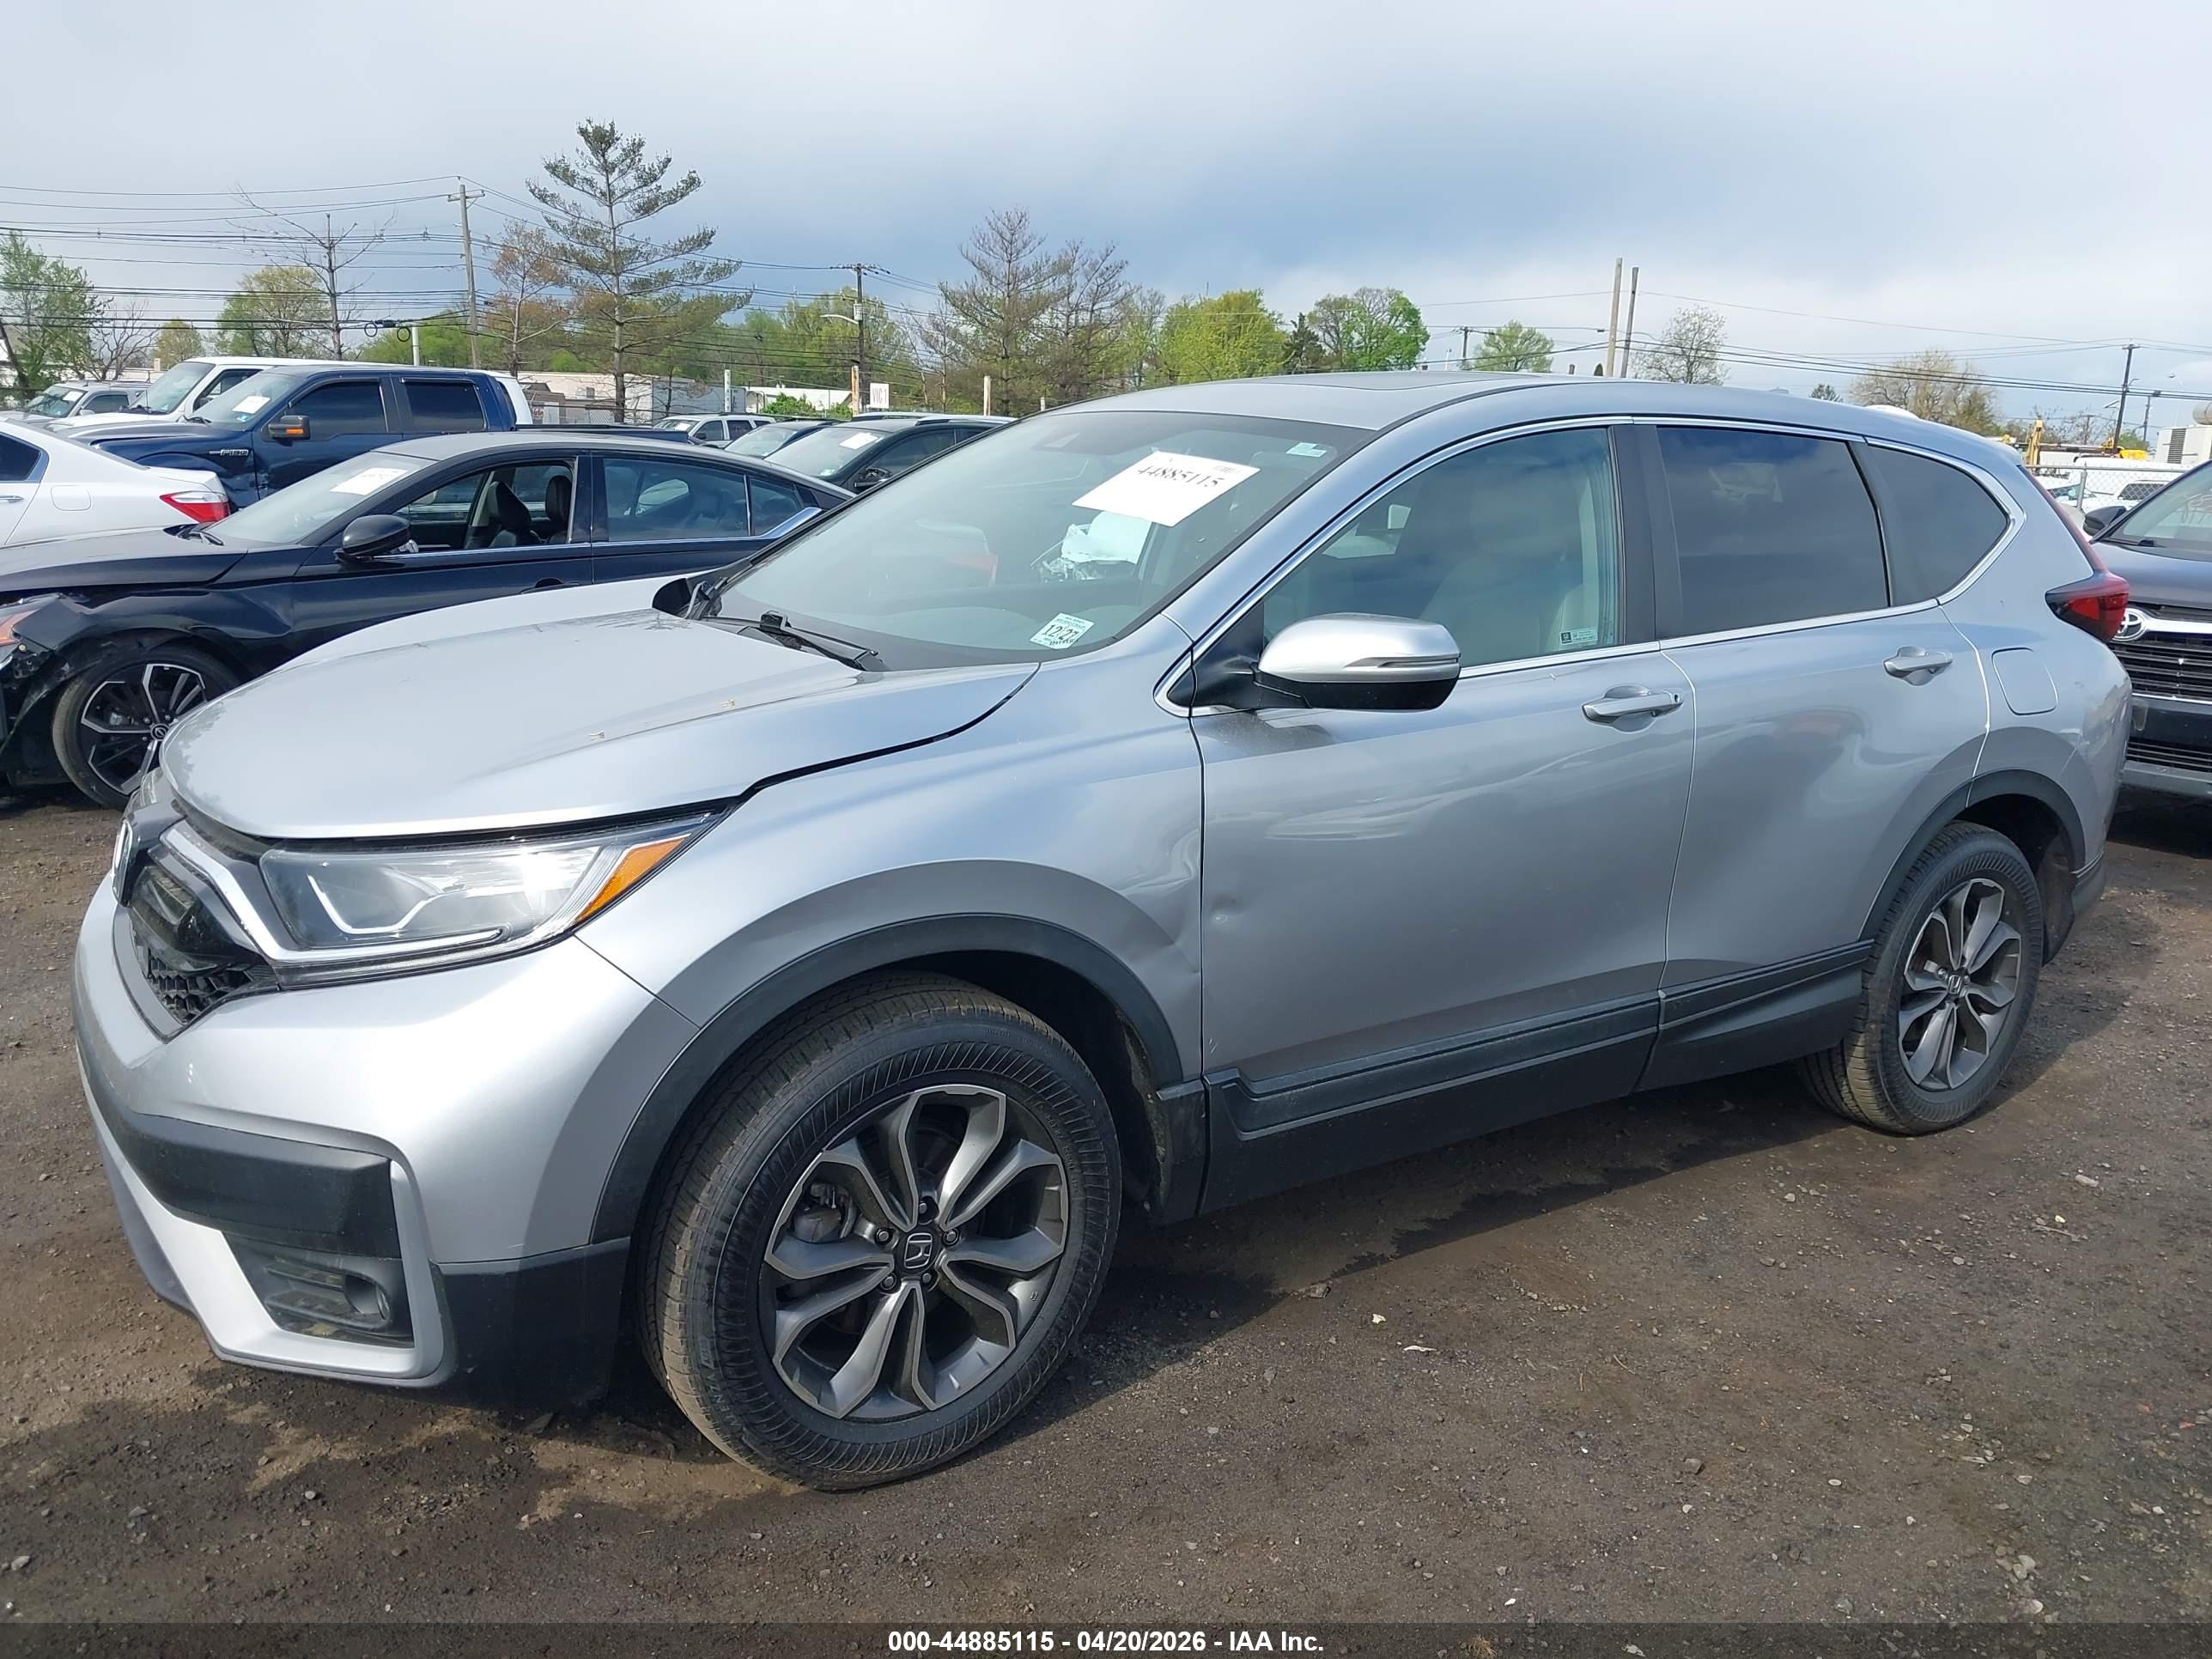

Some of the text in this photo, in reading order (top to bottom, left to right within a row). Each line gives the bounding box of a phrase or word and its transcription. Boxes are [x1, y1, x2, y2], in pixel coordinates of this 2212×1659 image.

[872, 387, 883, 404] VIC
[1137, 465, 1225, 488] 44885115
[1042, 624, 1063, 637] 12
